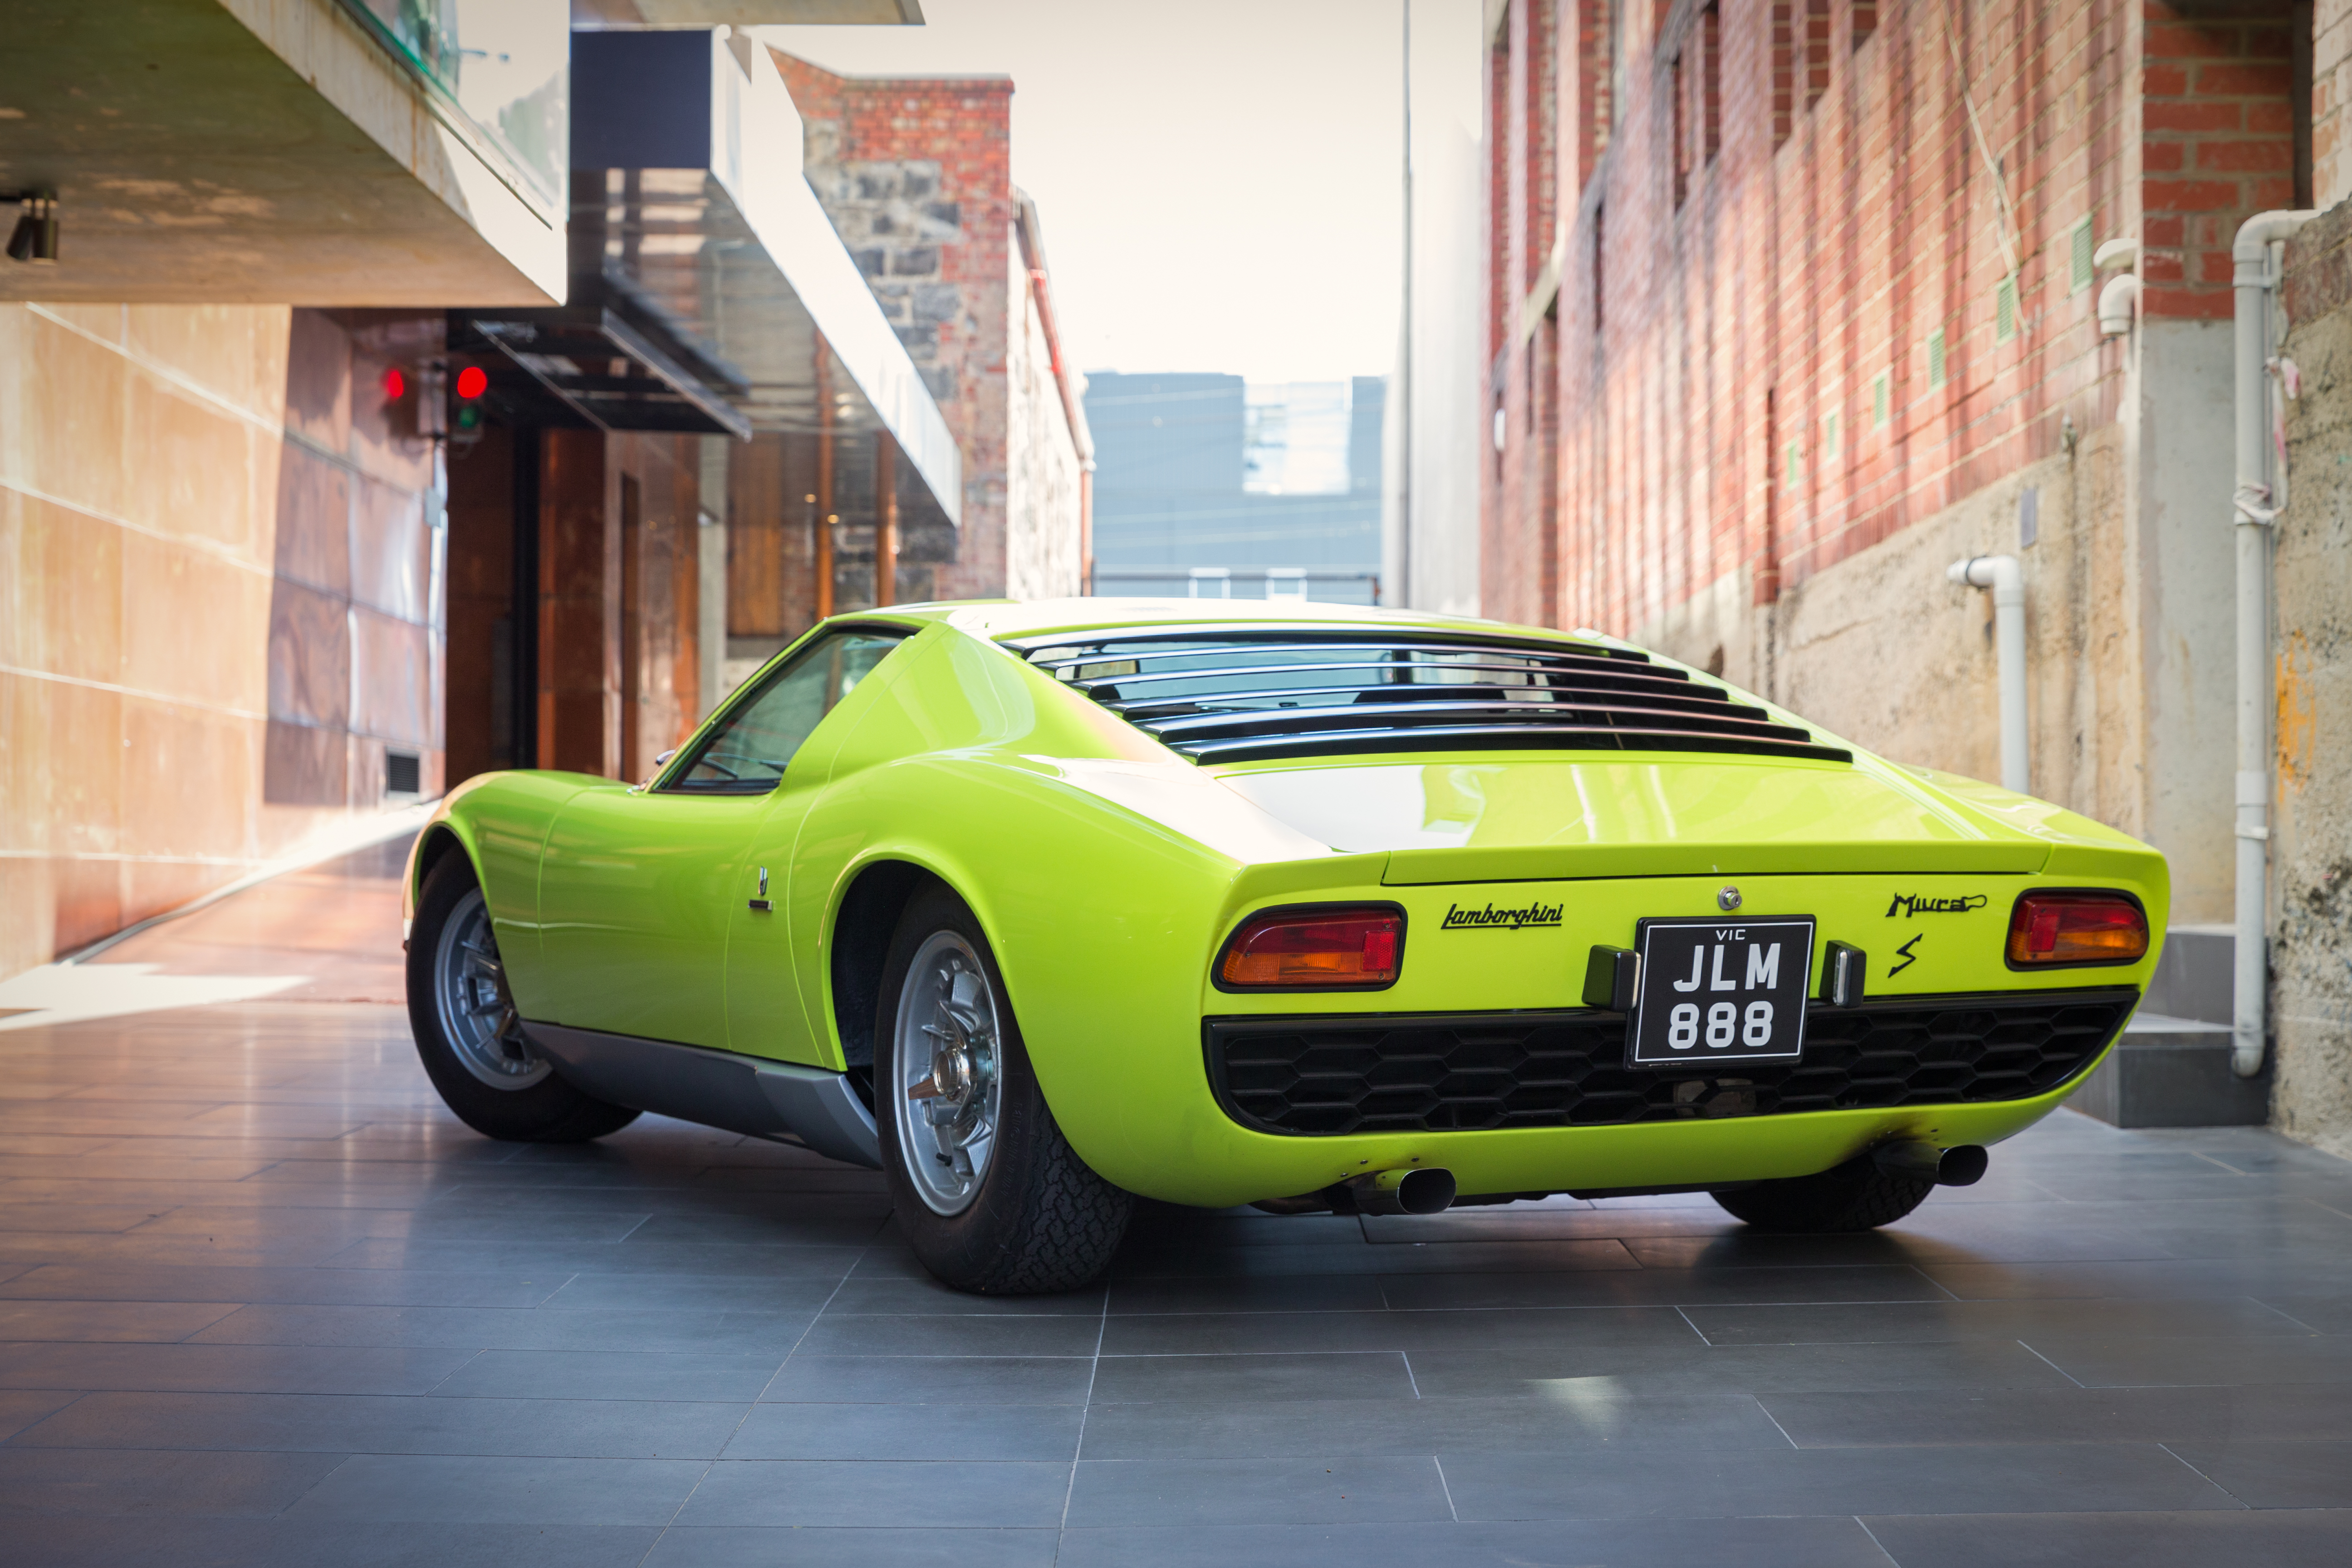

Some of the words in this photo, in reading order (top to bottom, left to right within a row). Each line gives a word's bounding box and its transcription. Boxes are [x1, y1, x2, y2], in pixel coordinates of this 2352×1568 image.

[1885, 892, 1987, 917] Miura
[1716, 929, 1746, 941] VIC
[1673, 943, 1781, 992] JLM
[1668, 1001, 1774, 1049] 888
